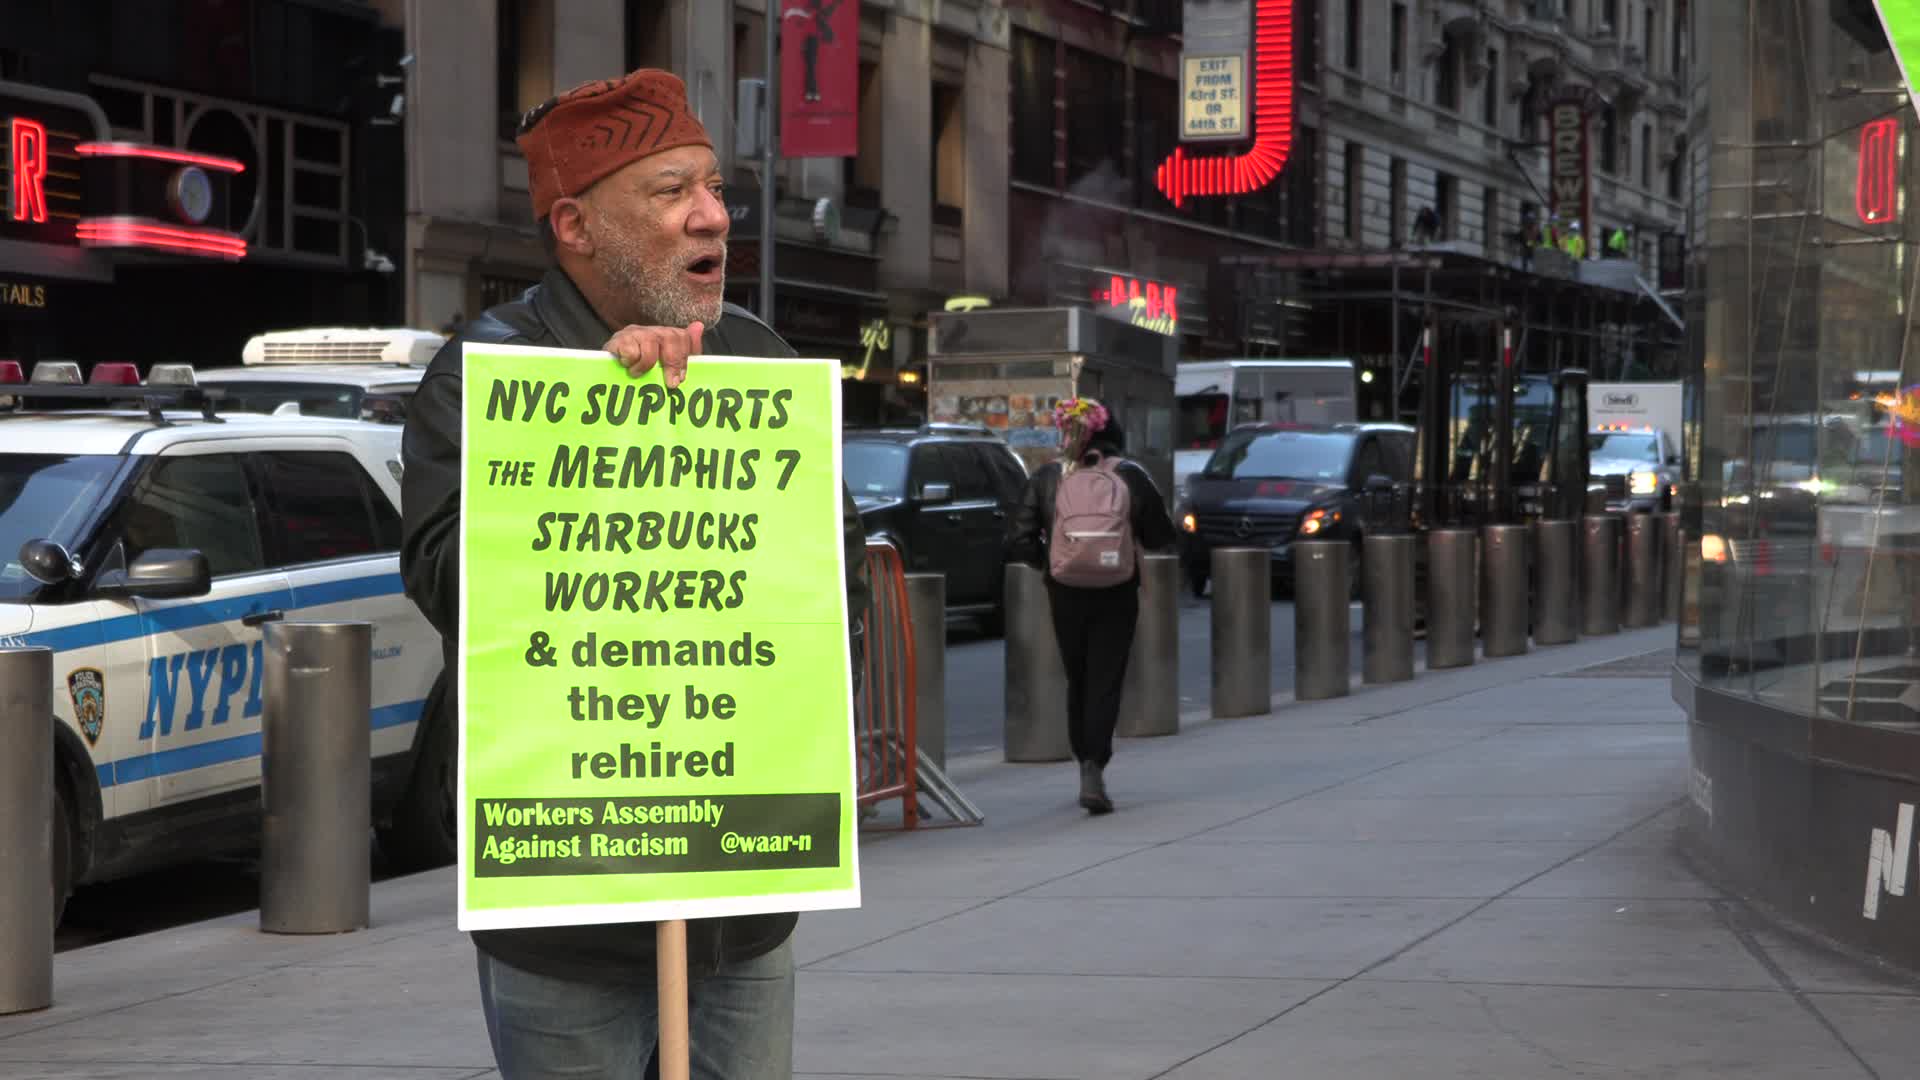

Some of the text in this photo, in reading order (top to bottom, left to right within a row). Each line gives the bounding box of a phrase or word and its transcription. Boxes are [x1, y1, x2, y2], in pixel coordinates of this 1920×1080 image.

[1195, 73, 1232, 87] FROM
[1199, 59, 1228, 72] EXIT
[1205, 103, 1222, 116] OR
[12, 117, 47, 223] R
[1110, 274, 1178, 321] PARK
[486, 379, 793, 432] NYC SUPPORTS
[488, 444, 801, 491] THE MEMPHIS 7
[532, 510, 759, 554] STARBUCKS
[545, 570, 747, 613] WORKERS
[524, 630, 776, 668] & demands
[567, 685, 737, 729] they be
[571, 741, 736, 779] rehired
[483, 799, 725, 829] Workers Assembly
[482, 831, 813, 866] Against Racism @waar-n
